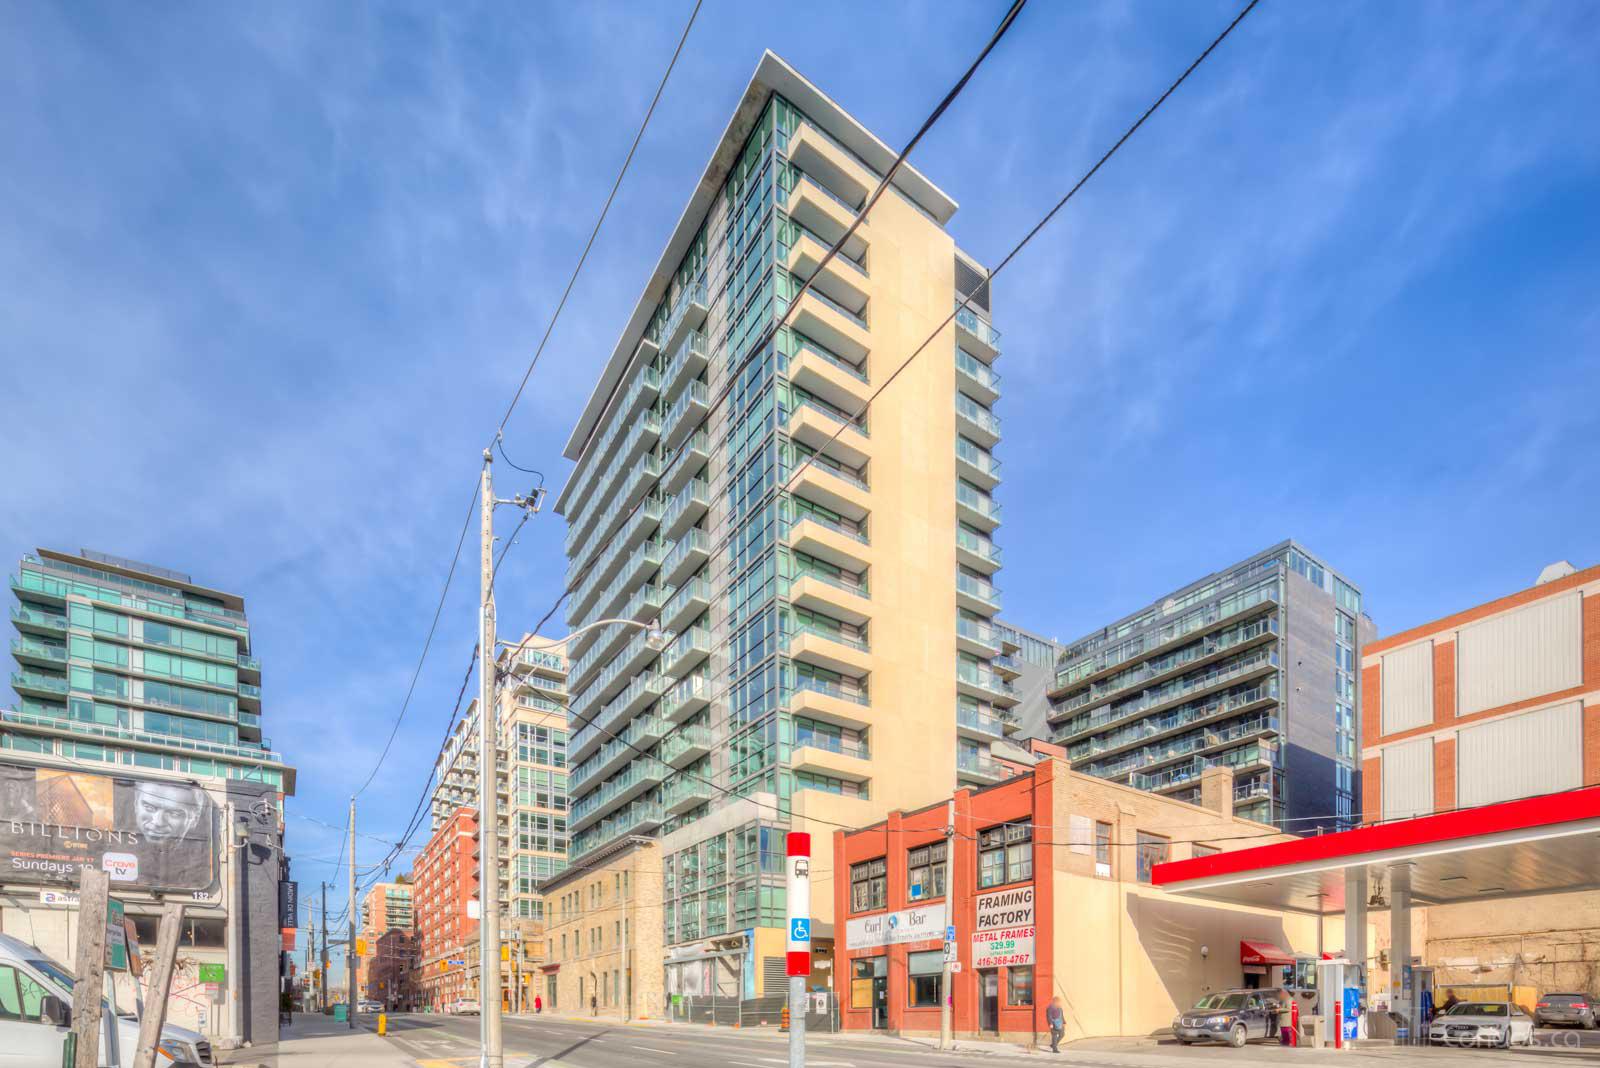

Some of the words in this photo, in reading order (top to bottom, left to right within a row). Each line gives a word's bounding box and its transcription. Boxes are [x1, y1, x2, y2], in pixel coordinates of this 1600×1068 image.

[11, 820, 139, 845] BILLIONS
[12, 857, 73, 874] Sundays
[104, 859, 136, 868] Crave
[115, 866, 127, 875] tv
[978, 890, 1032, 911] FRAMING
[864, 917, 882, 934] Curl
[909, 911, 927, 926] Bar
[978, 908, 1032, 928] FACTORY
[972, 932, 999, 943] METAL
[1000, 927, 1035, 940] FRAMES
[990, 940, 1015, 950] $29.99
